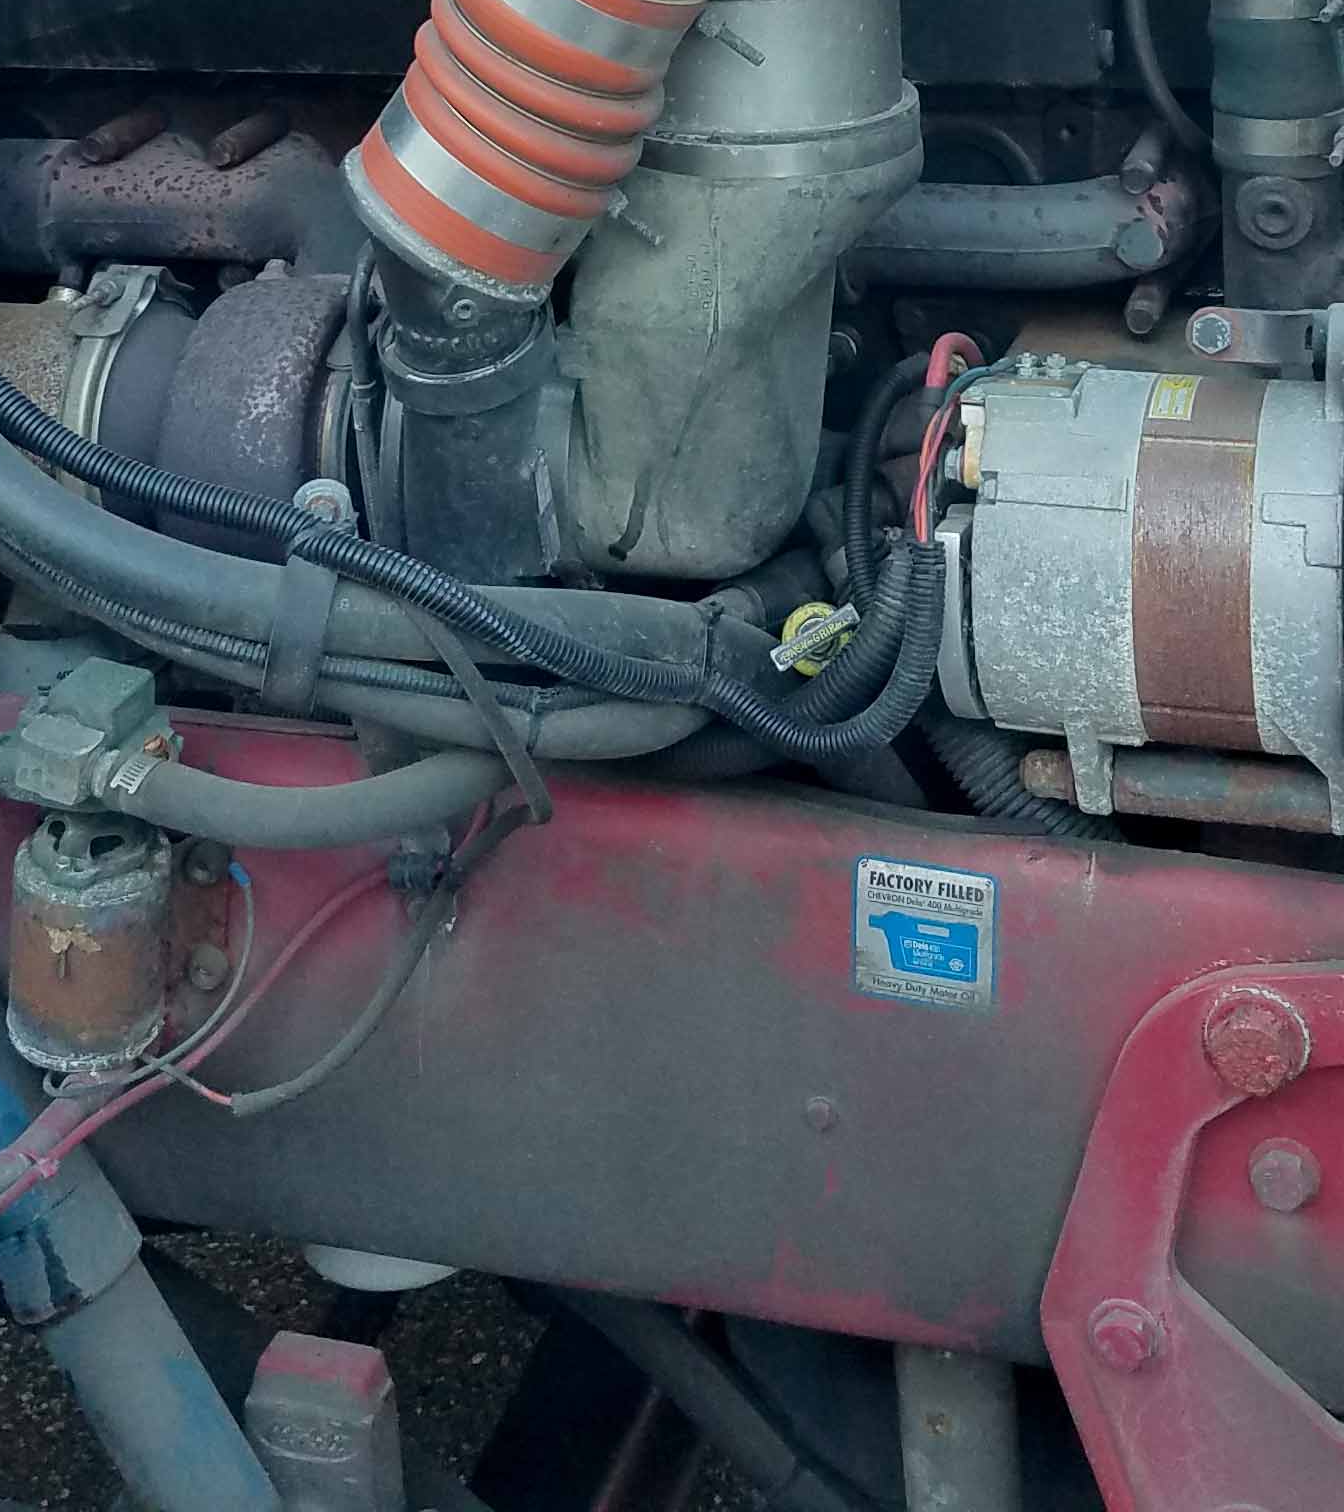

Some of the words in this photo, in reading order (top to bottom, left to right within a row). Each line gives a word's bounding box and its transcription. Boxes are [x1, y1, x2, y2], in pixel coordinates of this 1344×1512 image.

[867, 890, 905, 904] CHEVRON
[869, 870, 933, 895] FACTORY
[938, 881, 985, 902] FILLED
[872, 976, 903, 993] Heavy
[905, 982, 926, 995] Duty
[930, 986, 958, 999] Motor
[960, 990, 975, 1001] Oil
